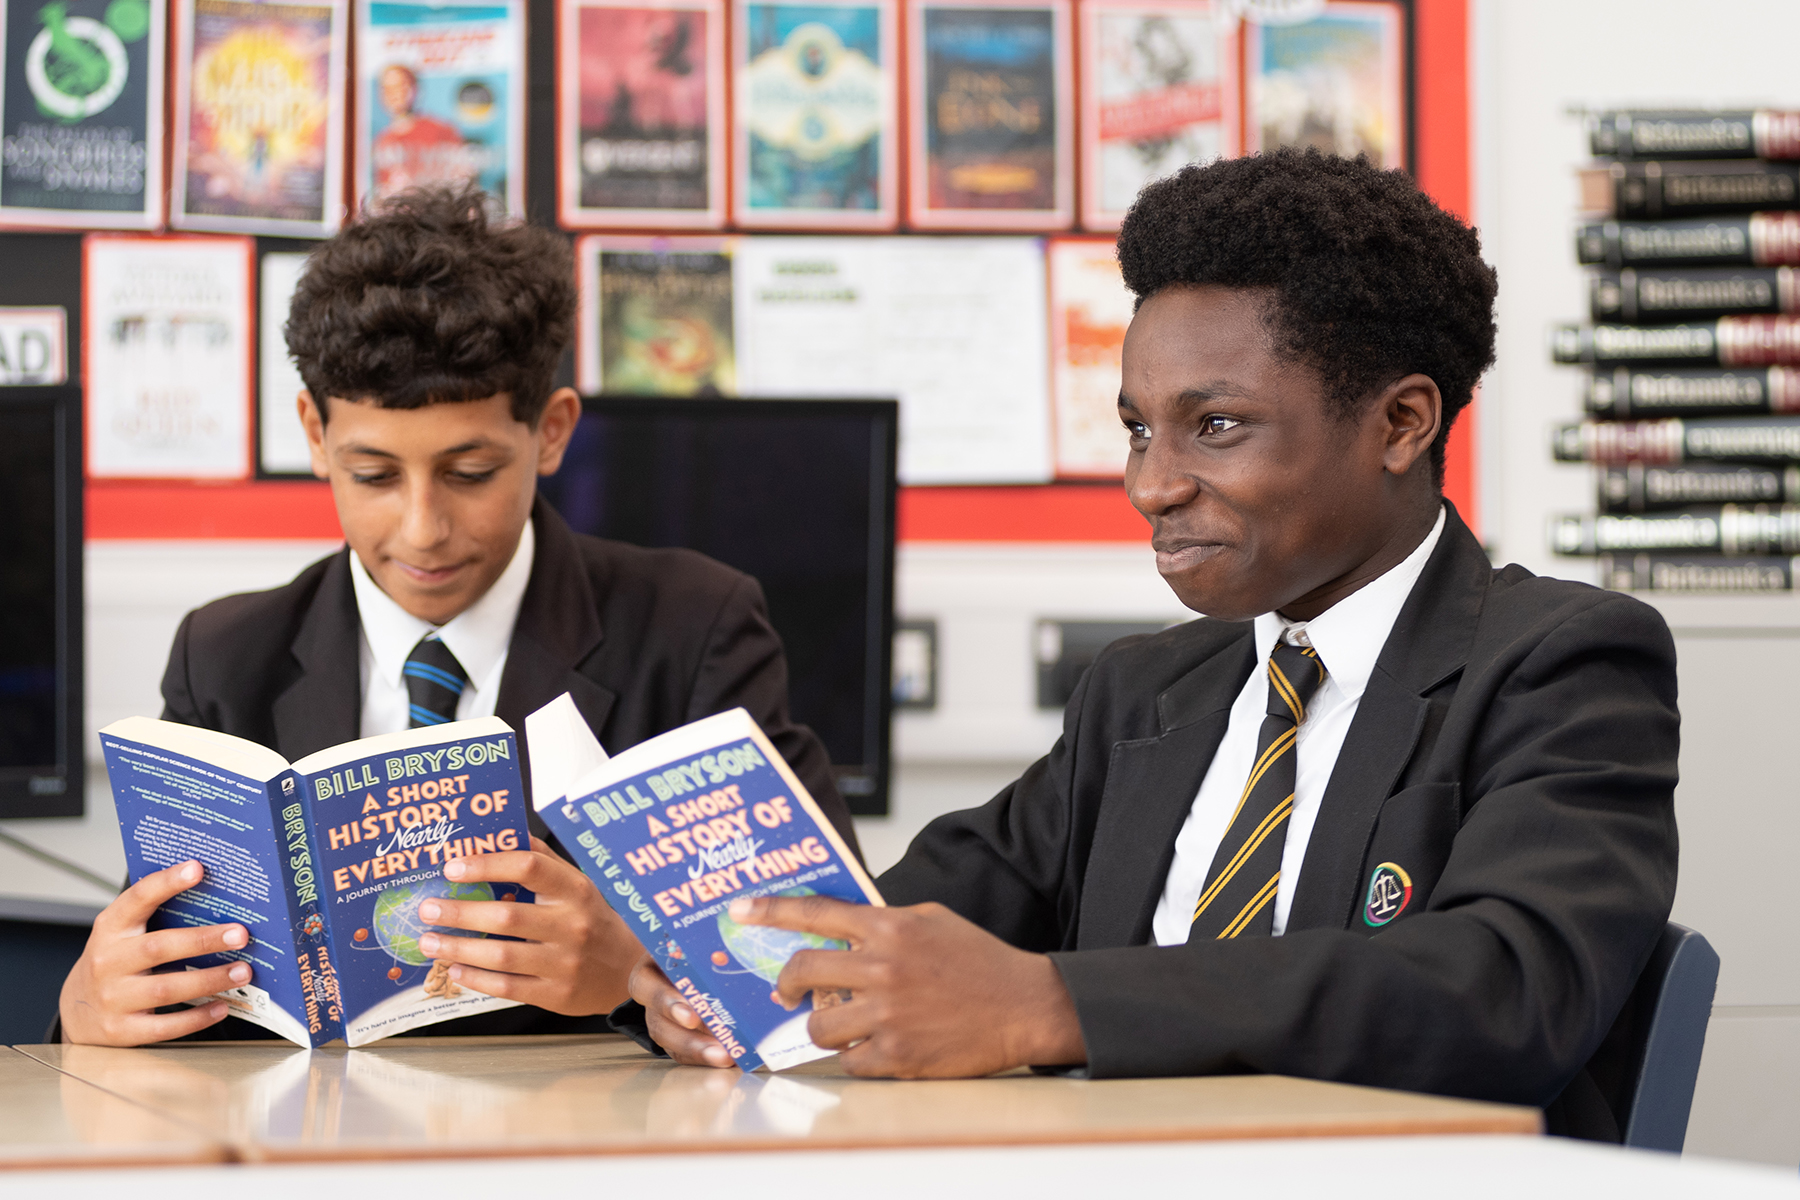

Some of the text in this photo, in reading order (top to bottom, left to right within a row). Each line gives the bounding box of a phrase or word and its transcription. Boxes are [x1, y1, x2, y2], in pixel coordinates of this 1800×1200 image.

[315, 739, 511, 801] BILL BRYSON
[362, 774, 470, 815] A SHORT
[582, 743, 767, 828] BILL BRYSON
[329, 789, 510, 850] HISTORY OF
[376, 815, 465, 858] Nearly
[624, 795, 793, 877] HISTORY OF
[646, 784, 745, 838] A SHORT
[282, 803, 318, 907] BRYSON
[333, 829, 519, 892] EVERYTHING
[653, 837, 830, 917] EVERYTHING
[688, 829, 766, 880] Nearly
[336, 870, 441, 905] A JOURNEY THROUGH
[673, 921, 682, 930] A
[681, 904, 723, 929] JOURNEY
[768, 878, 796, 894] SPACE
[796, 871, 818, 884] AND
[818, 863, 841, 878] TIME
[297, 953, 323, 1035] EVERYTHING
[317, 946, 341, 1023] HISTORY OF
[434, 1001, 457, 1011] better
[675, 977, 747, 1059] EVERYTHING
